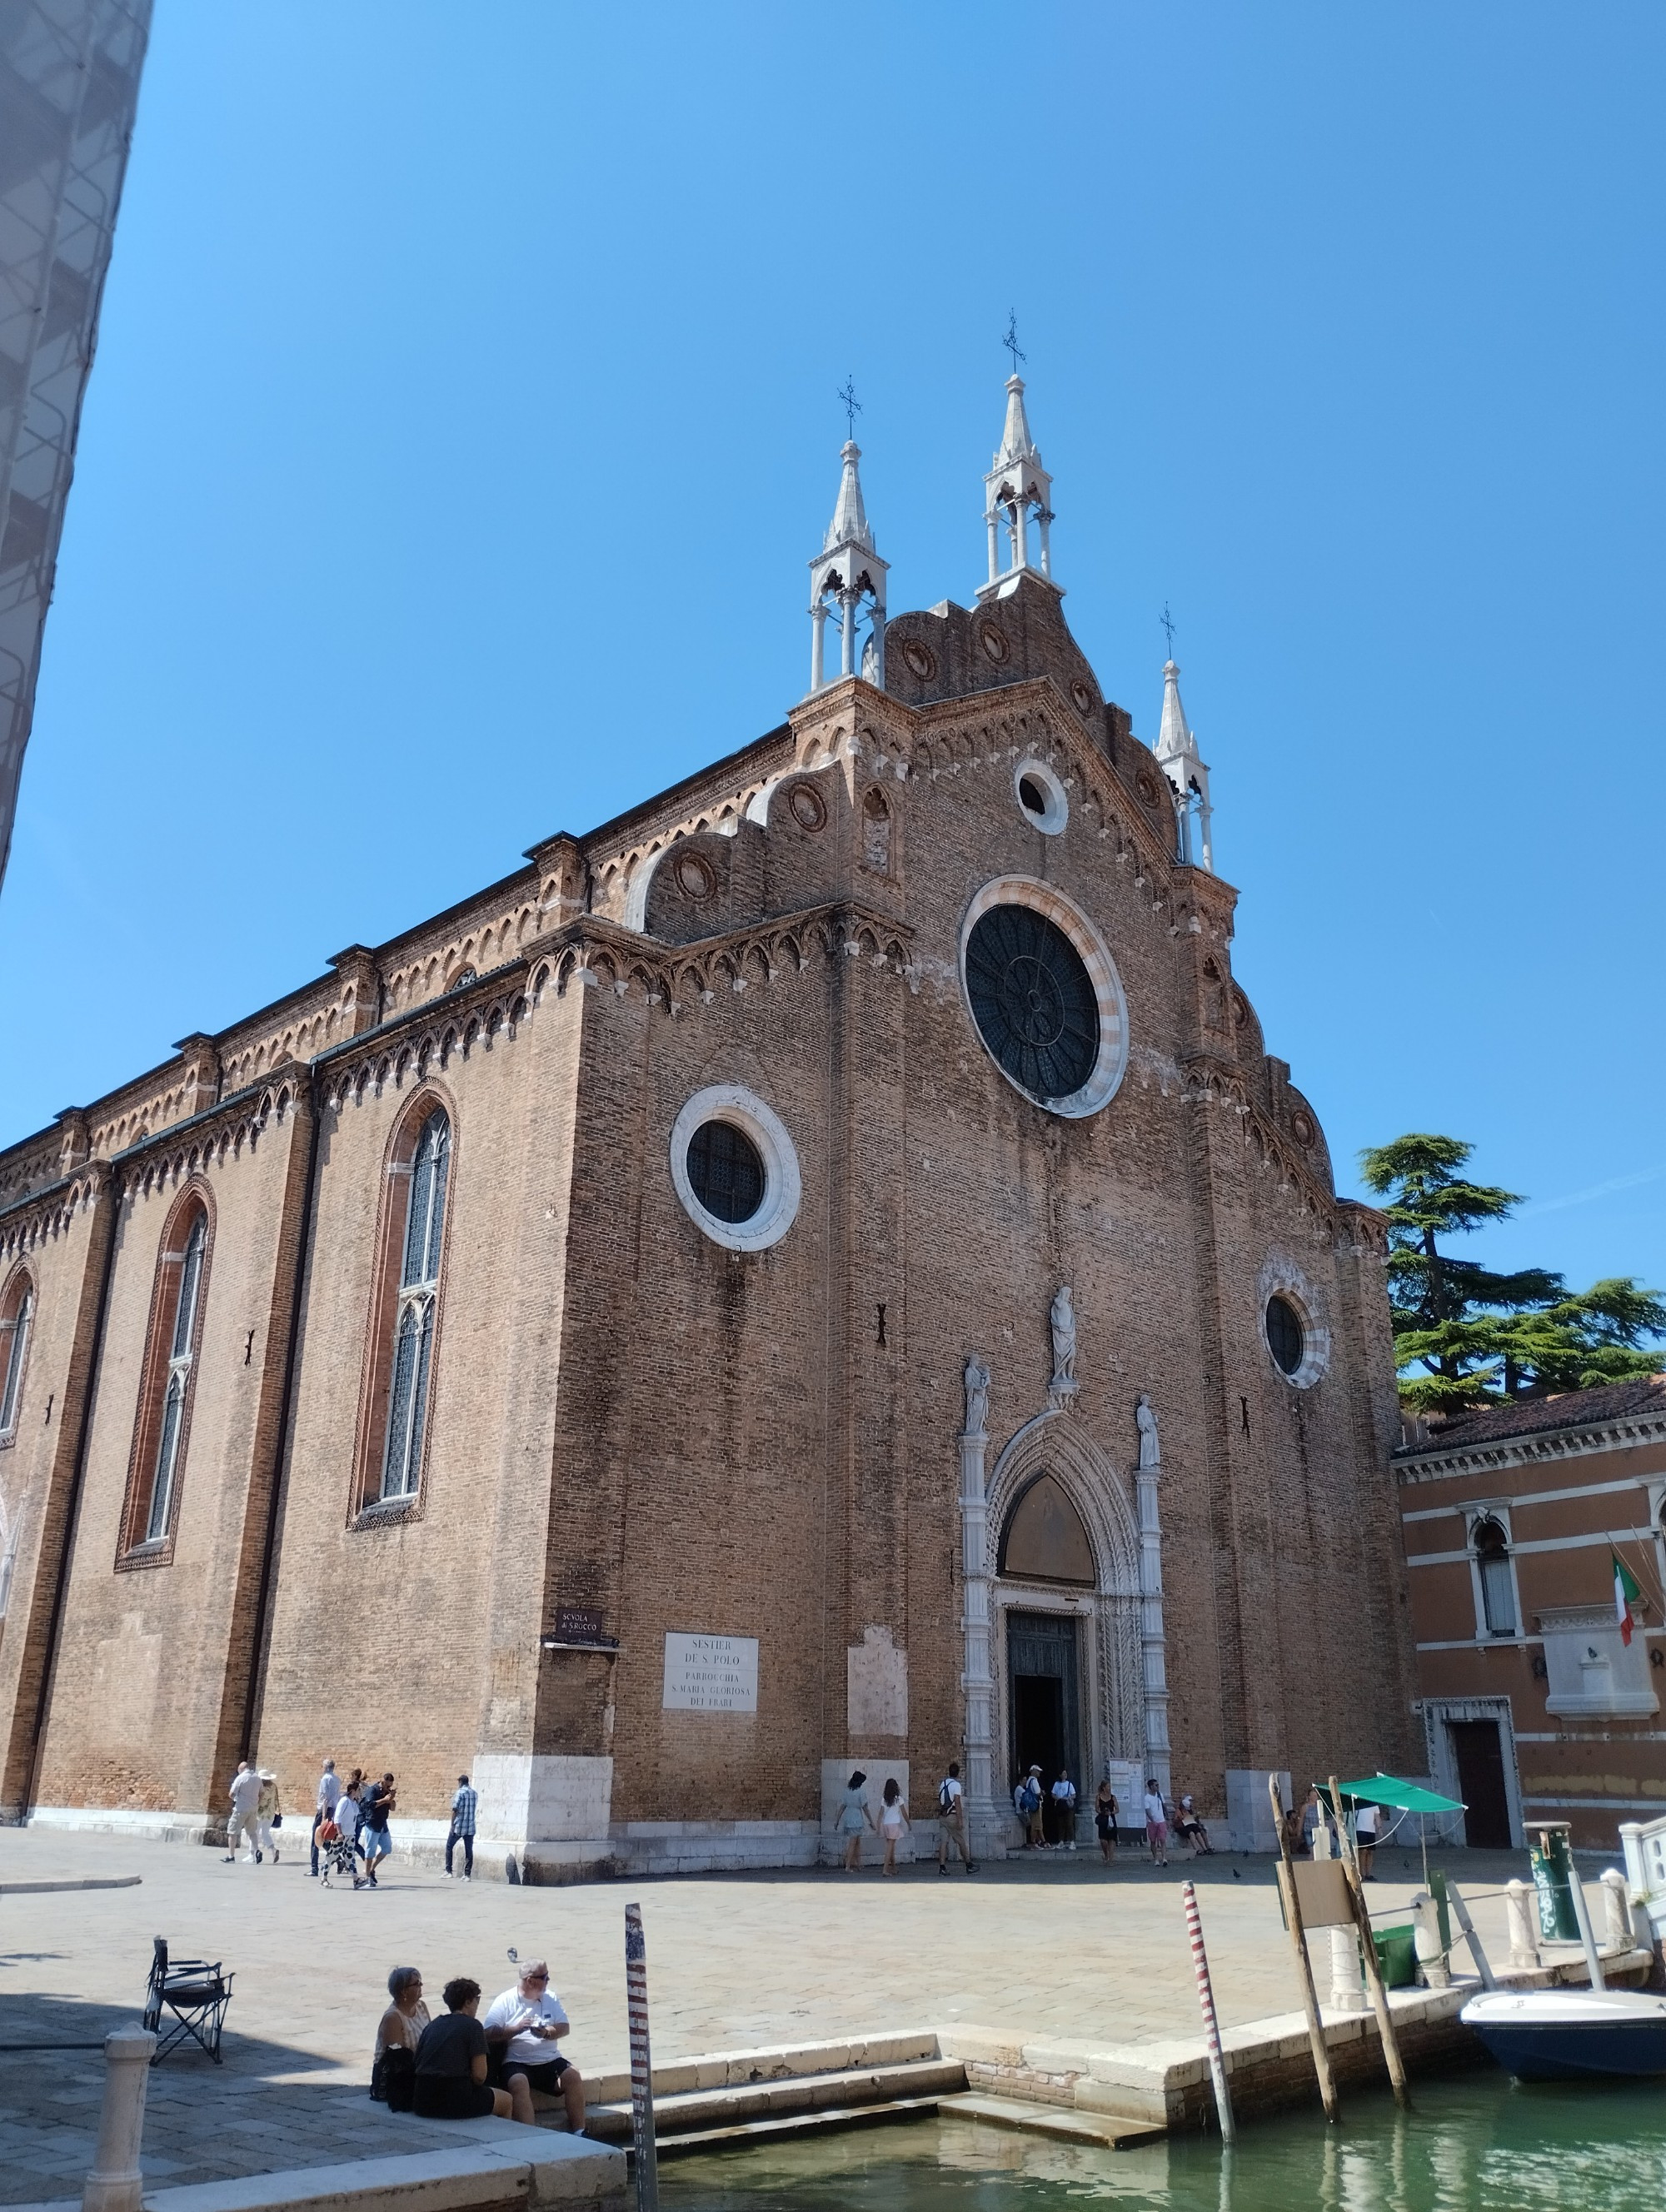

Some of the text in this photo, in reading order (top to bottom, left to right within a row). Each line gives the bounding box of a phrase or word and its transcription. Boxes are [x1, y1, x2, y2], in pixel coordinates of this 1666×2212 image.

[692, 1639, 731, 1650] SESTIER
[685, 1653, 698, 1663] DE
[714, 1655, 740, 1665] POLO
[686, 1671, 739, 1682] PARROCCHIA
[680, 1685, 705, 1694] MARIA
[710, 1686, 751, 1696] GLORIOSA
[691, 1697, 732, 1707] DEI FRARI
